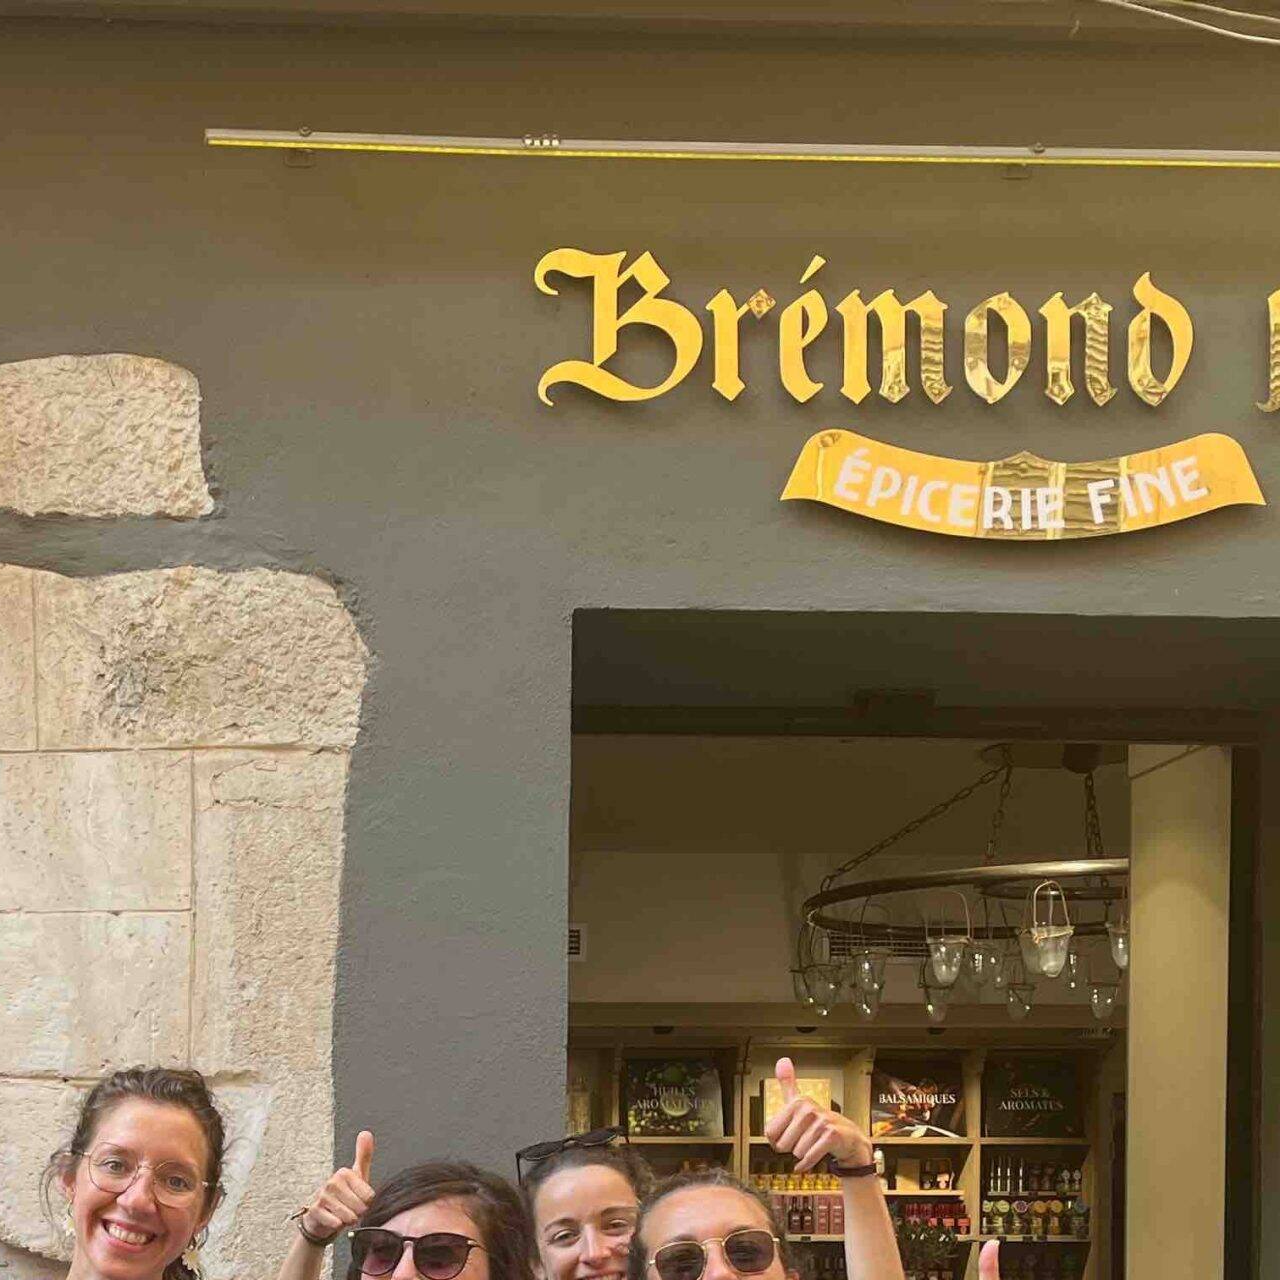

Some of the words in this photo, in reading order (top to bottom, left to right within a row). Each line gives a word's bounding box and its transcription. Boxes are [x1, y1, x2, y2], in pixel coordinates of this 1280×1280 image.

[534, 247, 1194, 407] Brémond
[833, 447, 1065, 531] ÉPICERIE
[1088, 454, 1211, 523] FINE
[878, 1093, 957, 1107] BALSAMIQUES
